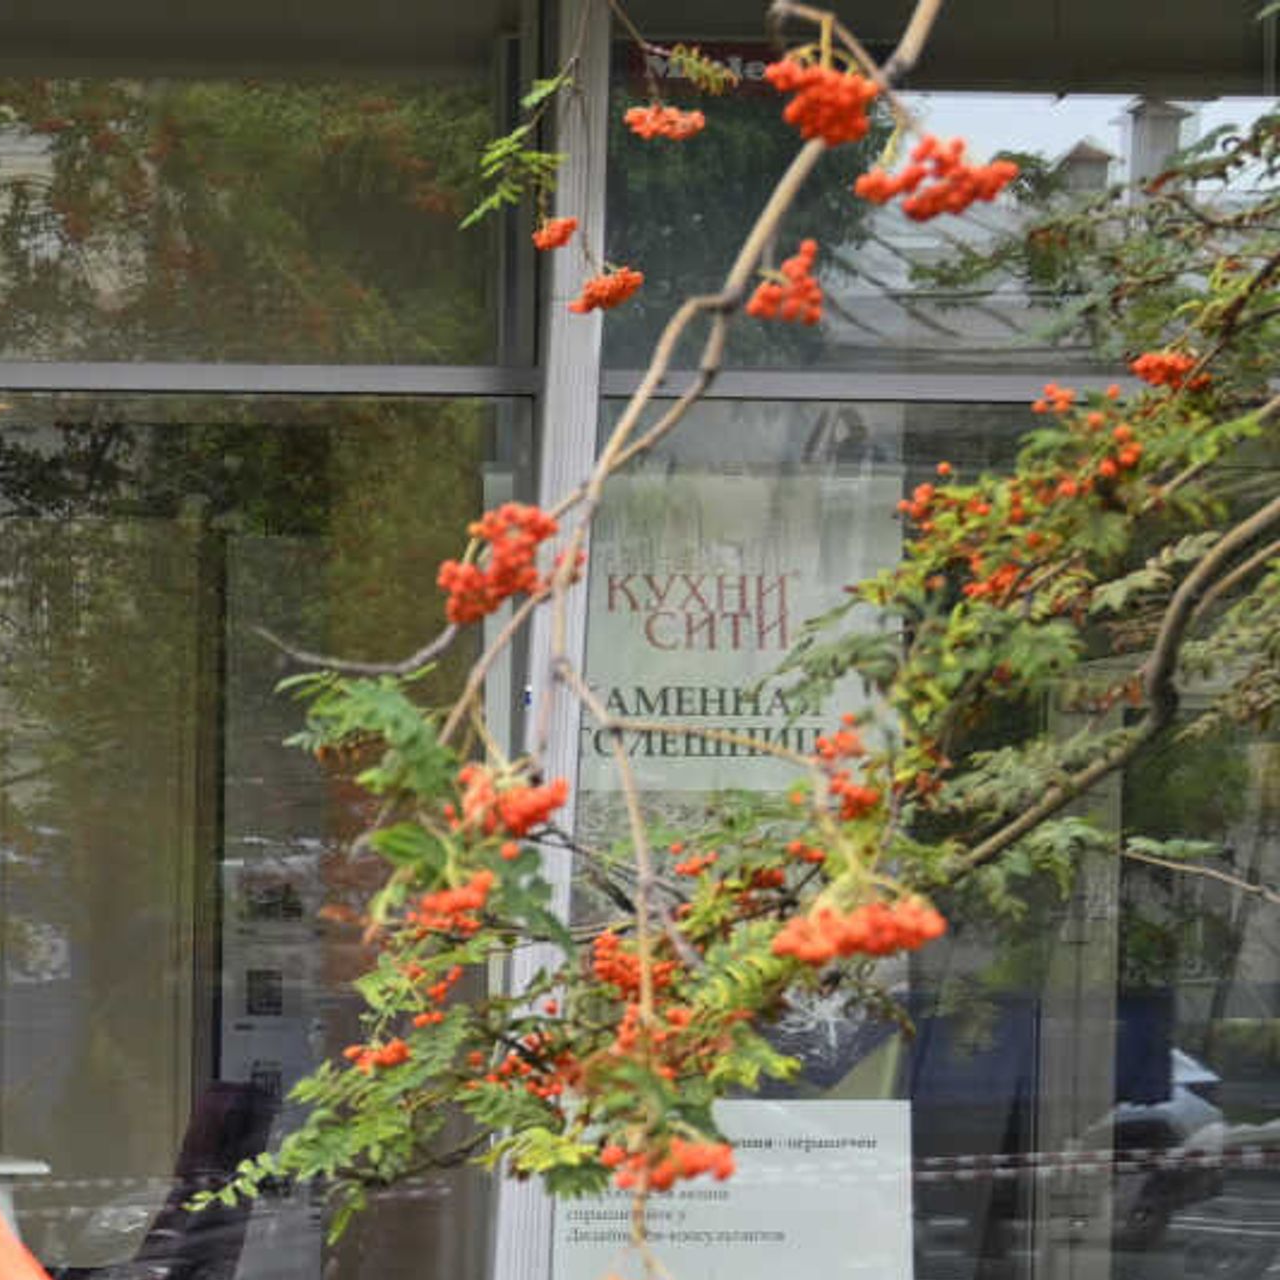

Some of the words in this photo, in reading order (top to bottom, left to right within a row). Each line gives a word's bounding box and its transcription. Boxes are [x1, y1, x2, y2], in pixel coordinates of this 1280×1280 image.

[607, 573, 792, 612] КУХНИ
[645, 611, 790, 651] СИТИ
[587, 686, 825, 717] АМЕННАЯ
